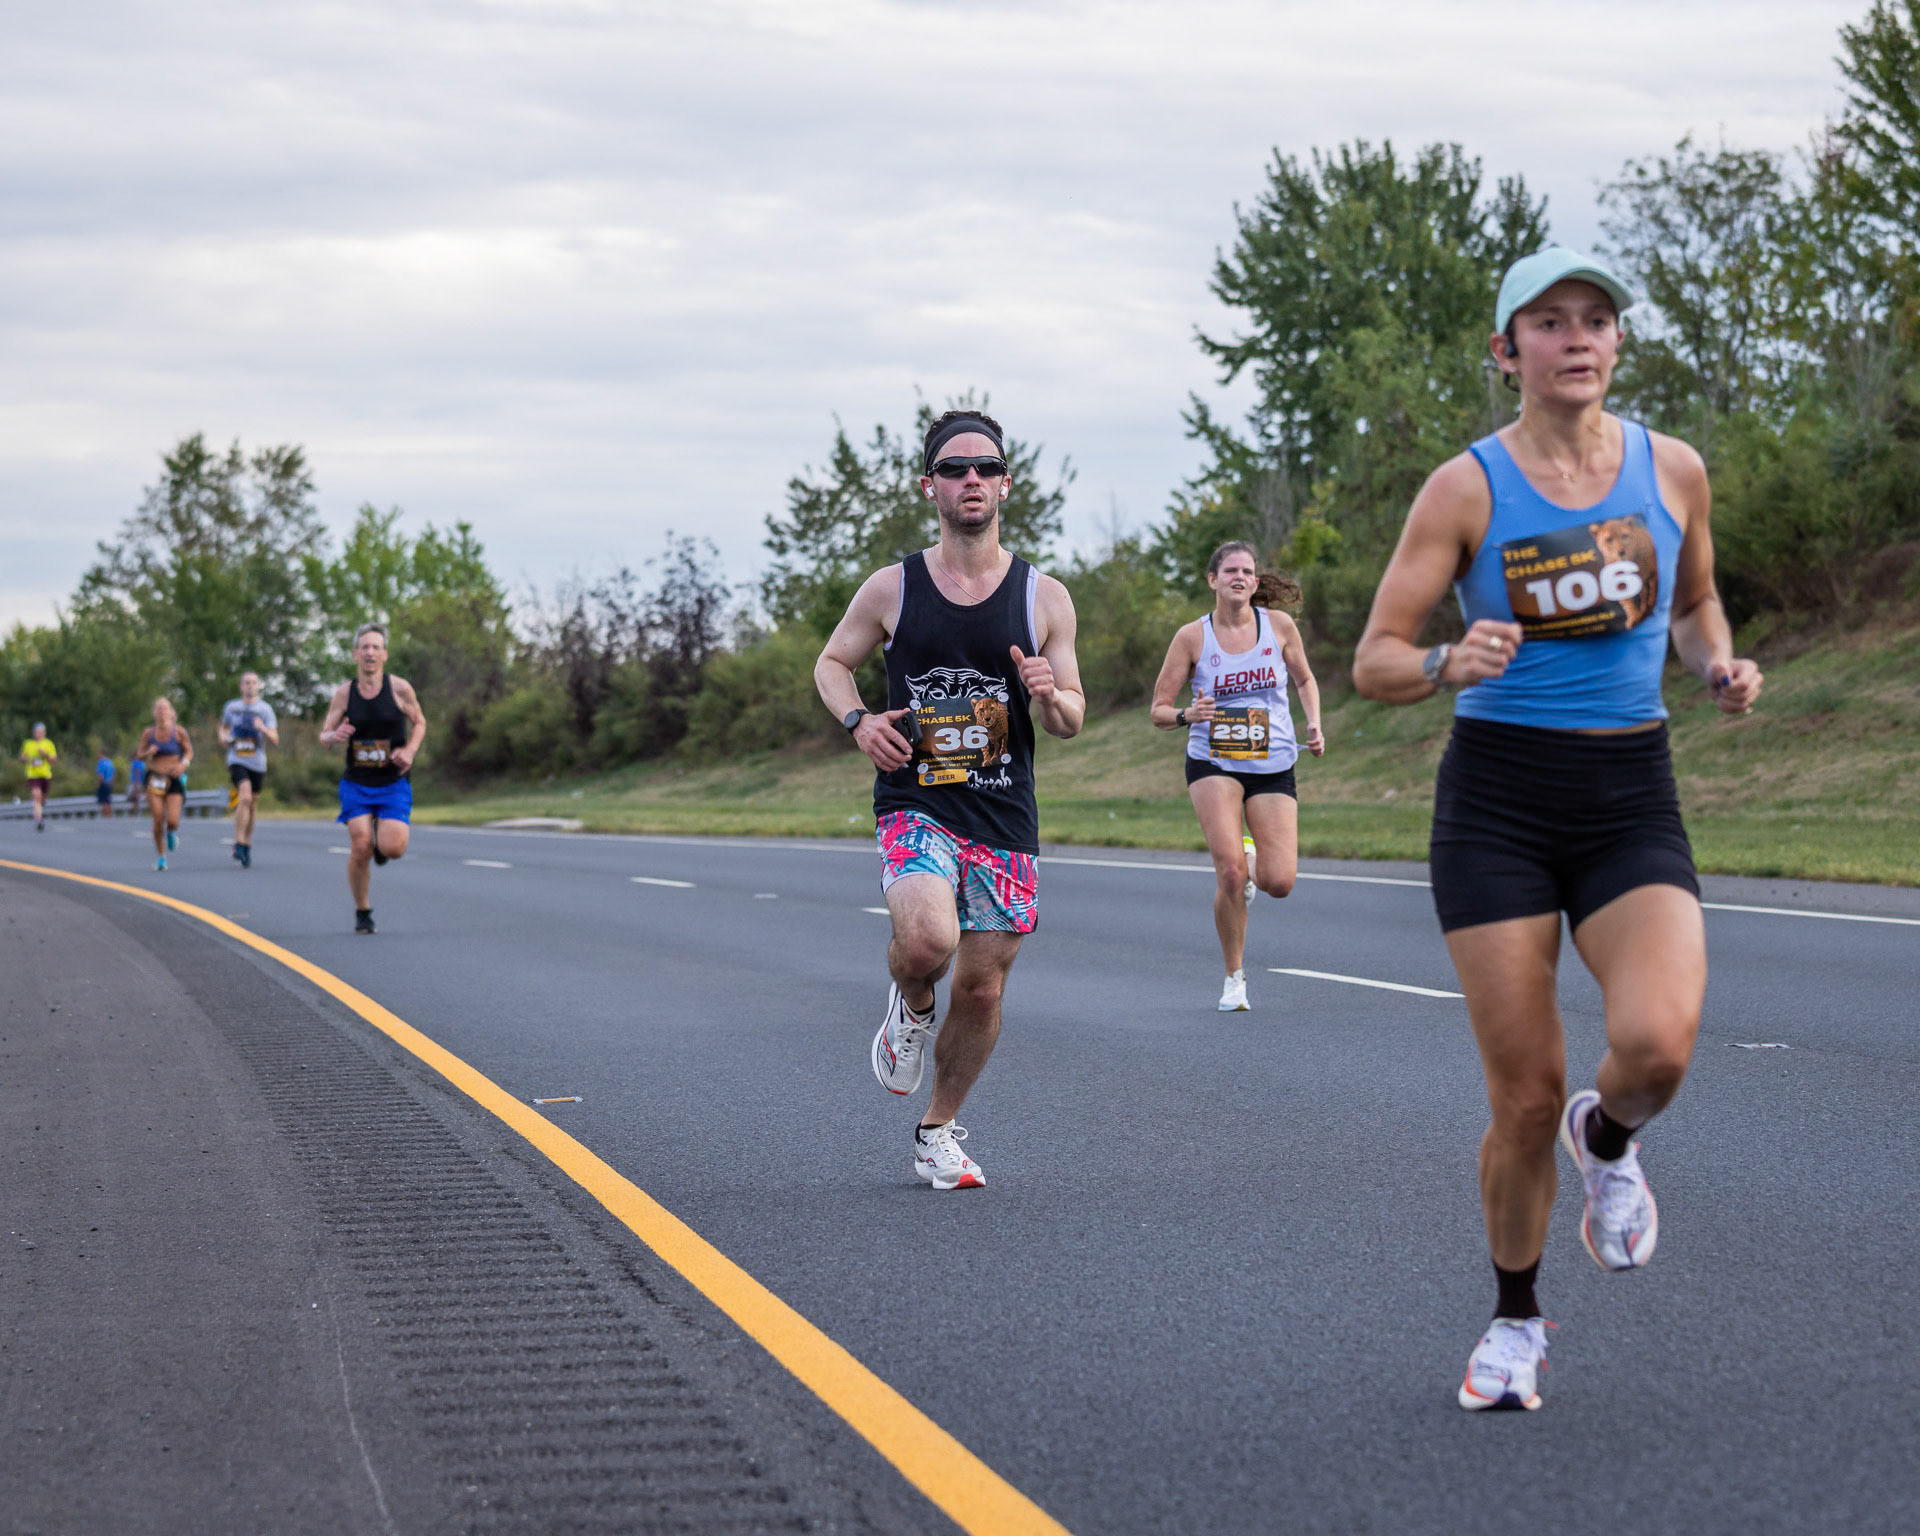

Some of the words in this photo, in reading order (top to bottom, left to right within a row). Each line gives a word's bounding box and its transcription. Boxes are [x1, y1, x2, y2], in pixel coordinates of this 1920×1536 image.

[1503, 546, 1538, 561] THE
[1505, 557, 1568, 578] CHASE
[1569, 549, 1597, 566] 5K
[1525, 560, 1643, 616] 106
[1214, 666, 1277, 689] LEONIA
[1213, 684, 1248, 696] TRACK
[1251, 680, 1277, 691] CLUB
[955, 714, 971, 723] 5K
[934, 725, 989, 752] 36
[1213, 724, 1265, 741] 236
